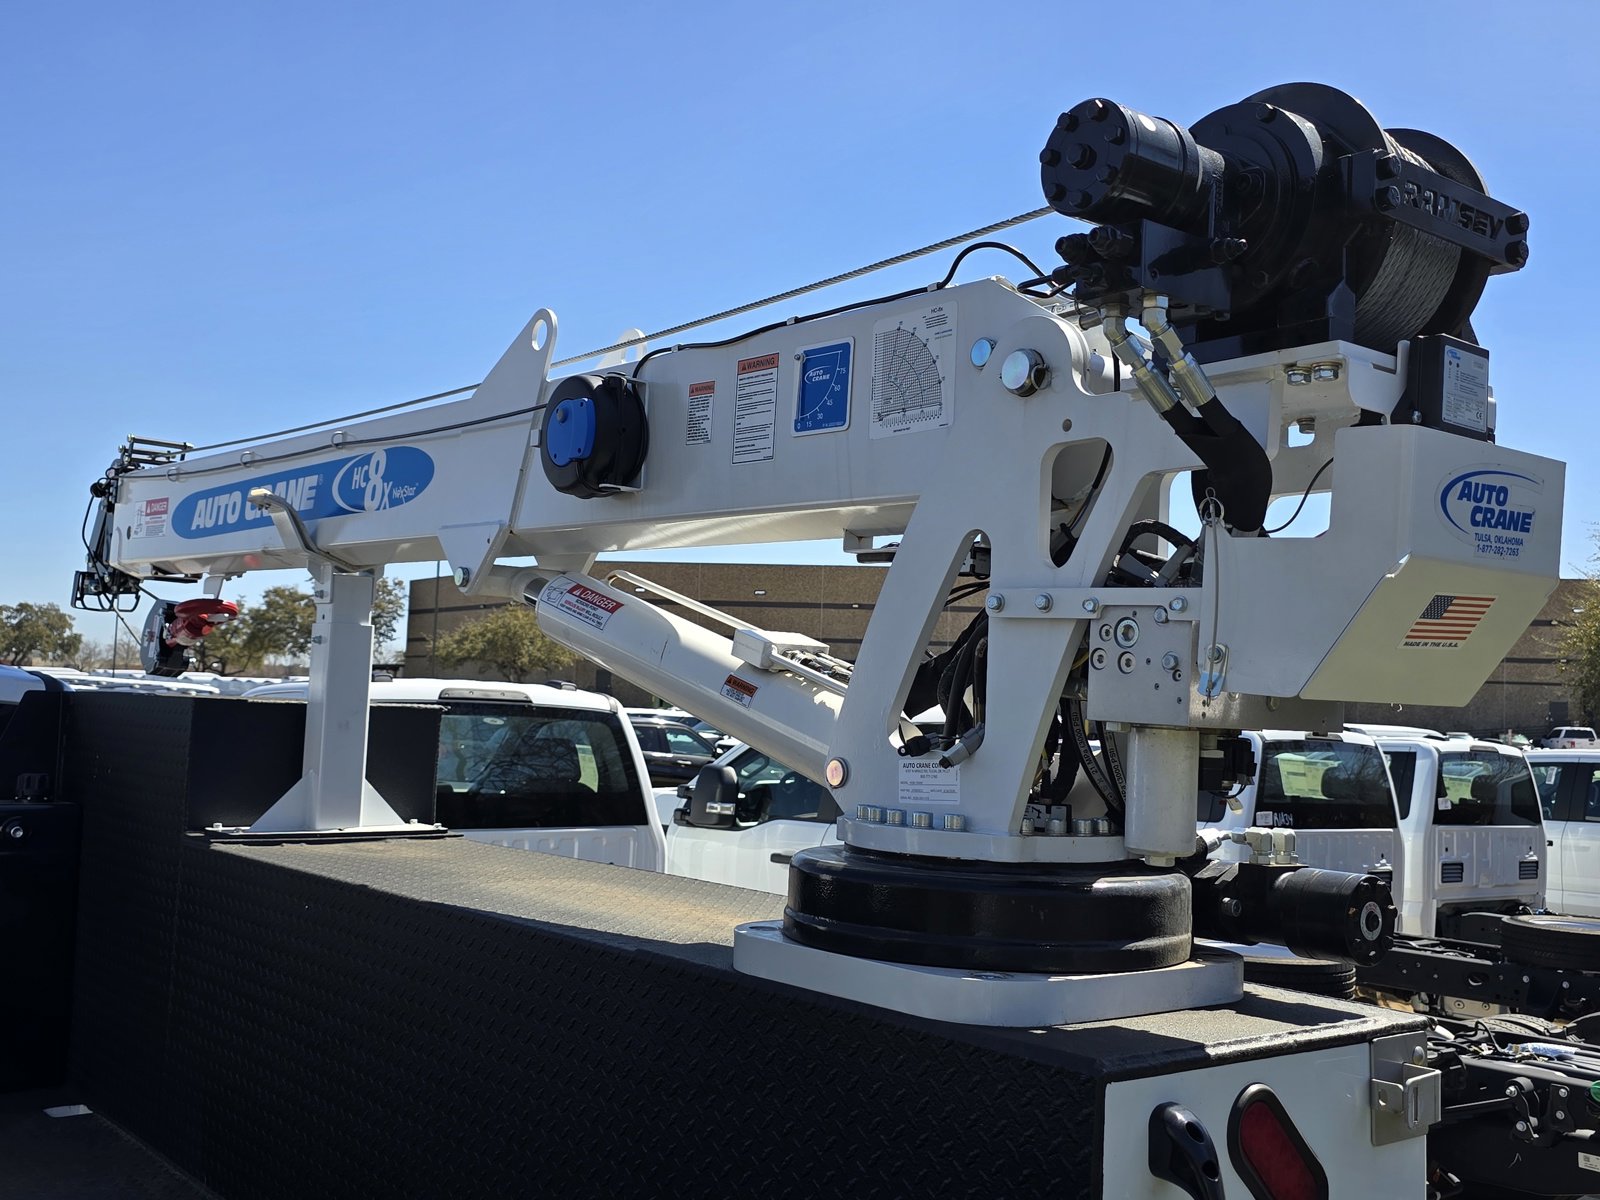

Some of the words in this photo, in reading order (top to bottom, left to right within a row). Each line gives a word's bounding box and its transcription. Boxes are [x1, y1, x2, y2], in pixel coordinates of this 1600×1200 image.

[1404, 180, 1504, 240] RAMSEY
[747, 357, 775, 369] WARNING
[1457, 480, 1508, 507] AUTO
[191, 490, 241, 530] AUTO
[1470, 505, 1533, 533] CRANE
[1494, 535, 1523, 547] OKLAHOMA
[581, 590, 616, 610] DANGER
